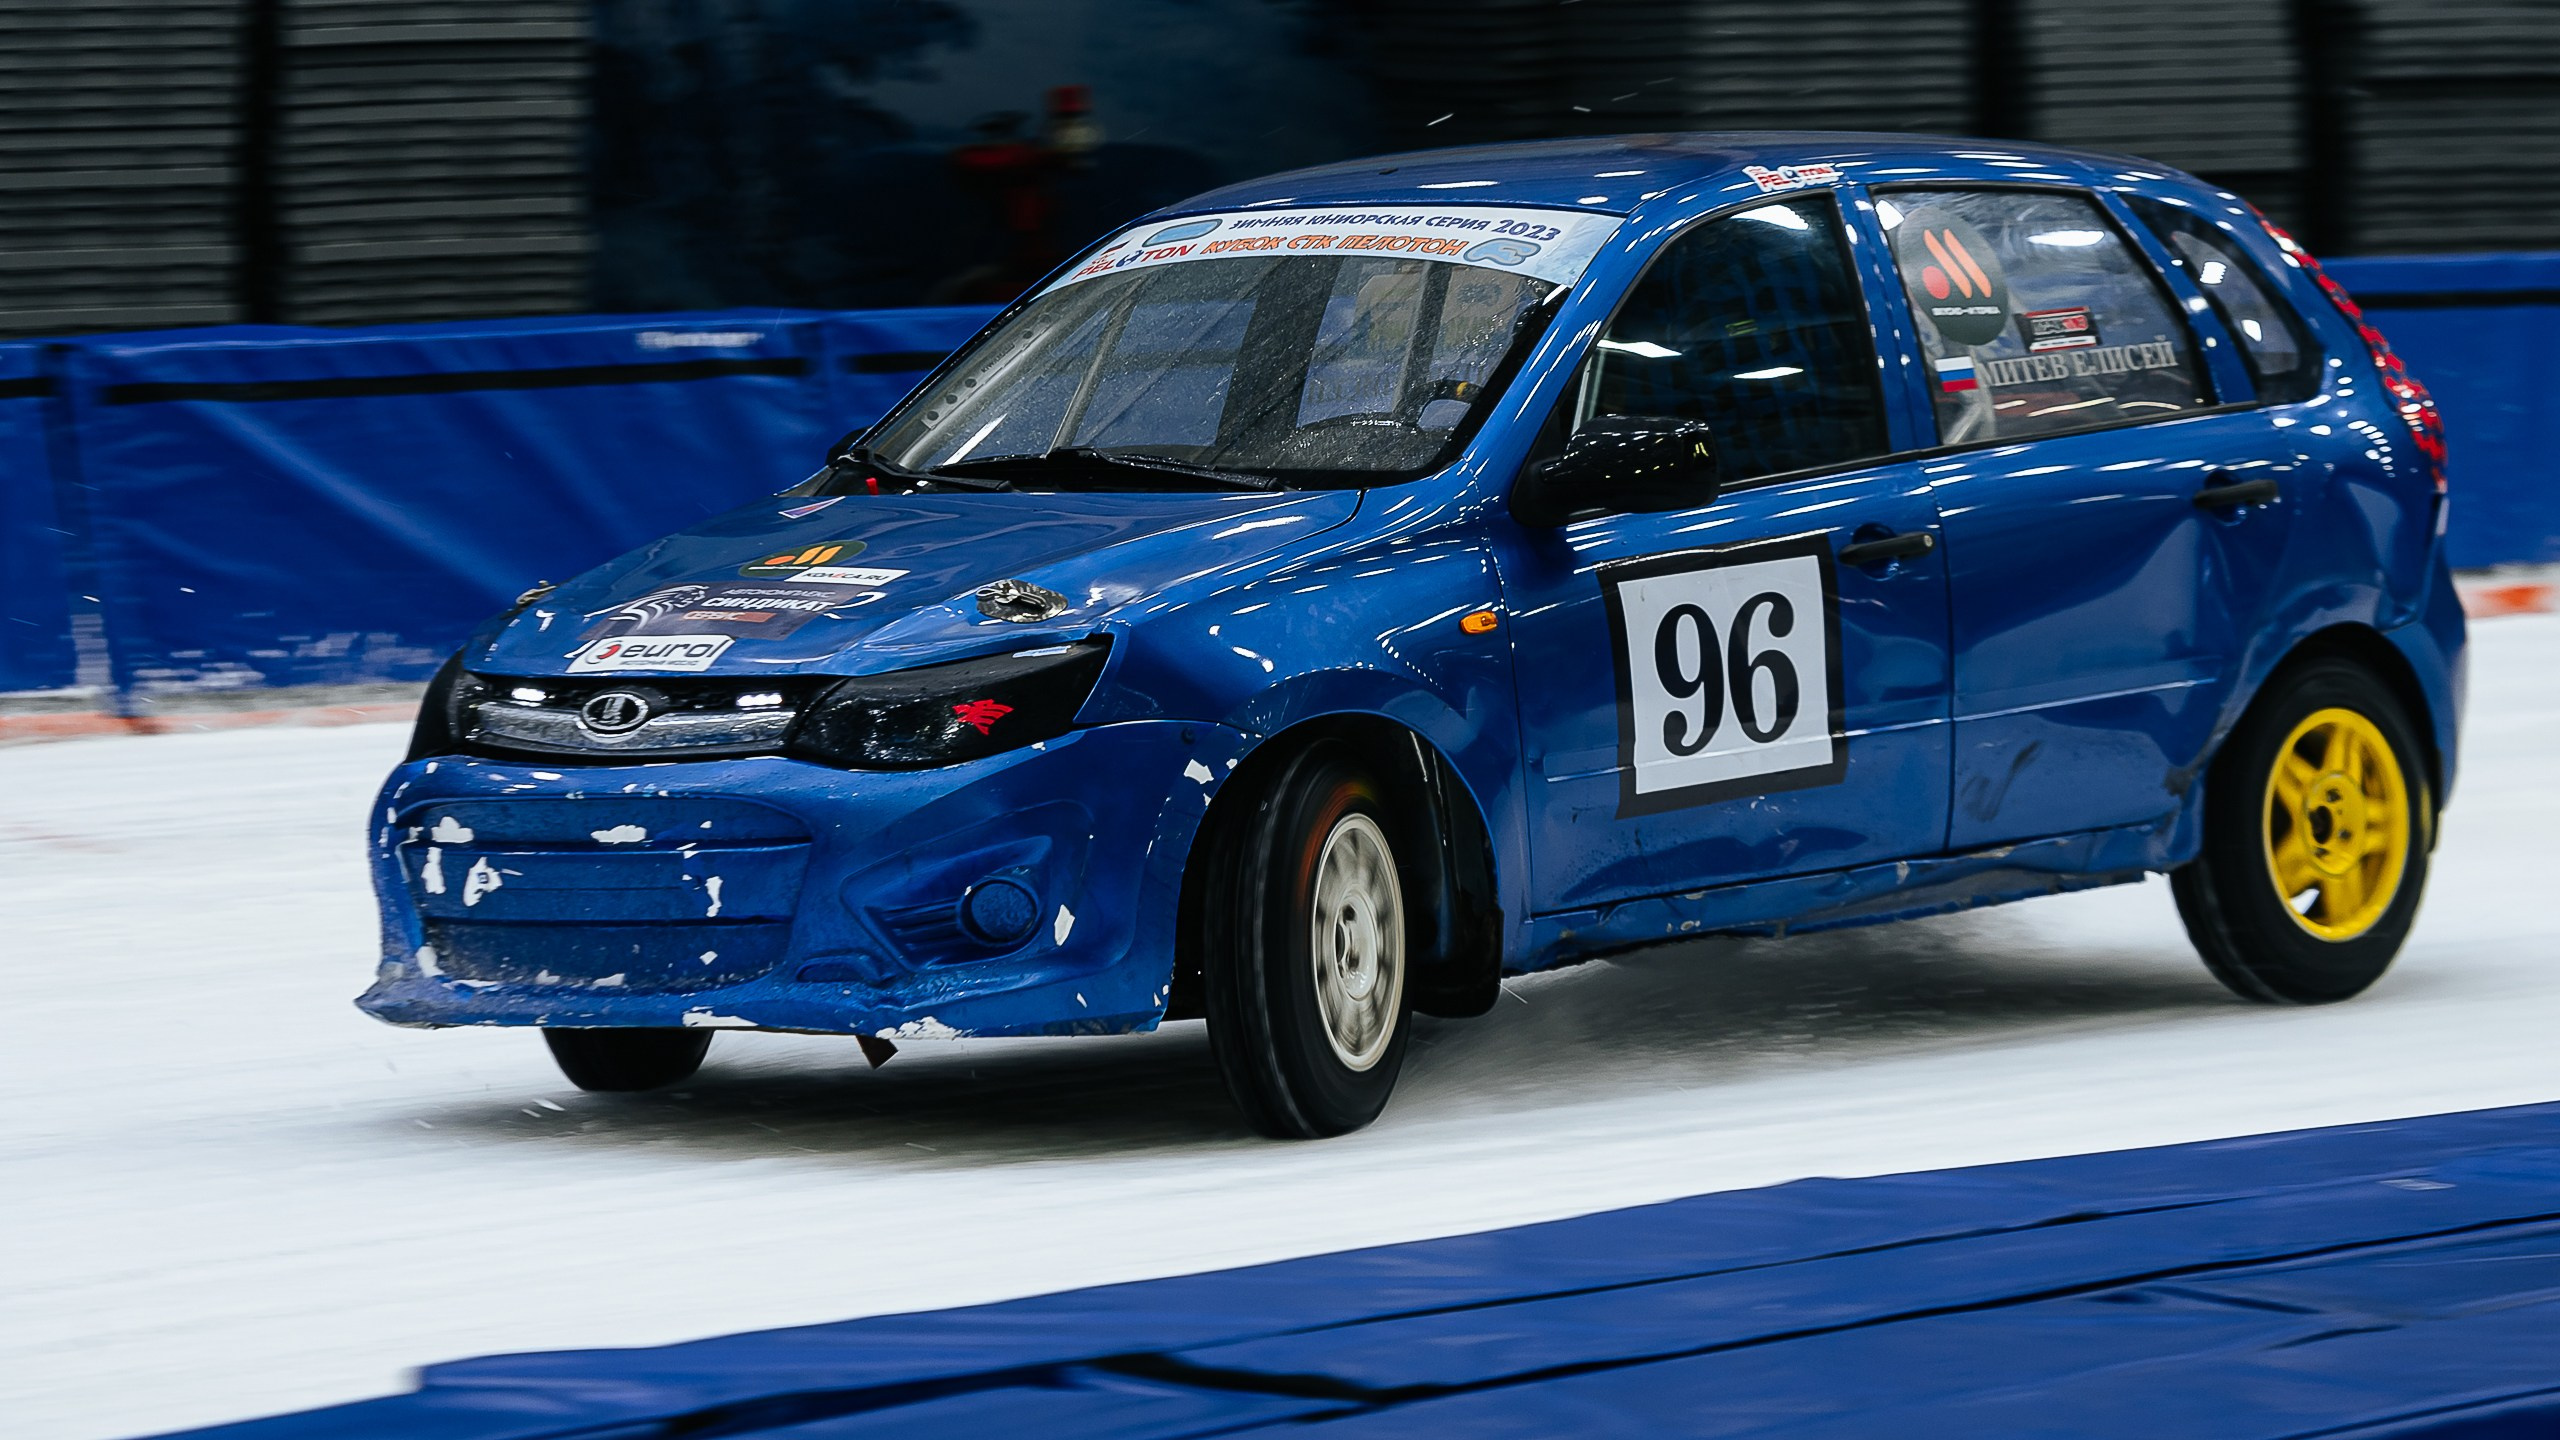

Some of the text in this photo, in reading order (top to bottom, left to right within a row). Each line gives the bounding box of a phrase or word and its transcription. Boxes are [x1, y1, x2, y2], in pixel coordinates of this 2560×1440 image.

[1229, 214, 1562, 242] ЗИМНЯЯ ЮНИОРСКАЯ СЕРИЯ 2023
[1200, 234, 1470, 257] КУБОК СТК ПЕЛОТОН
[1977, 334, 2180, 387] МИТЕВ ЕЛИСЕЙ
[701, 597, 836, 612] СИНДИКАТ
[620, 639, 732, 658] eurol
[1654, 591, 1800, 757] 96
